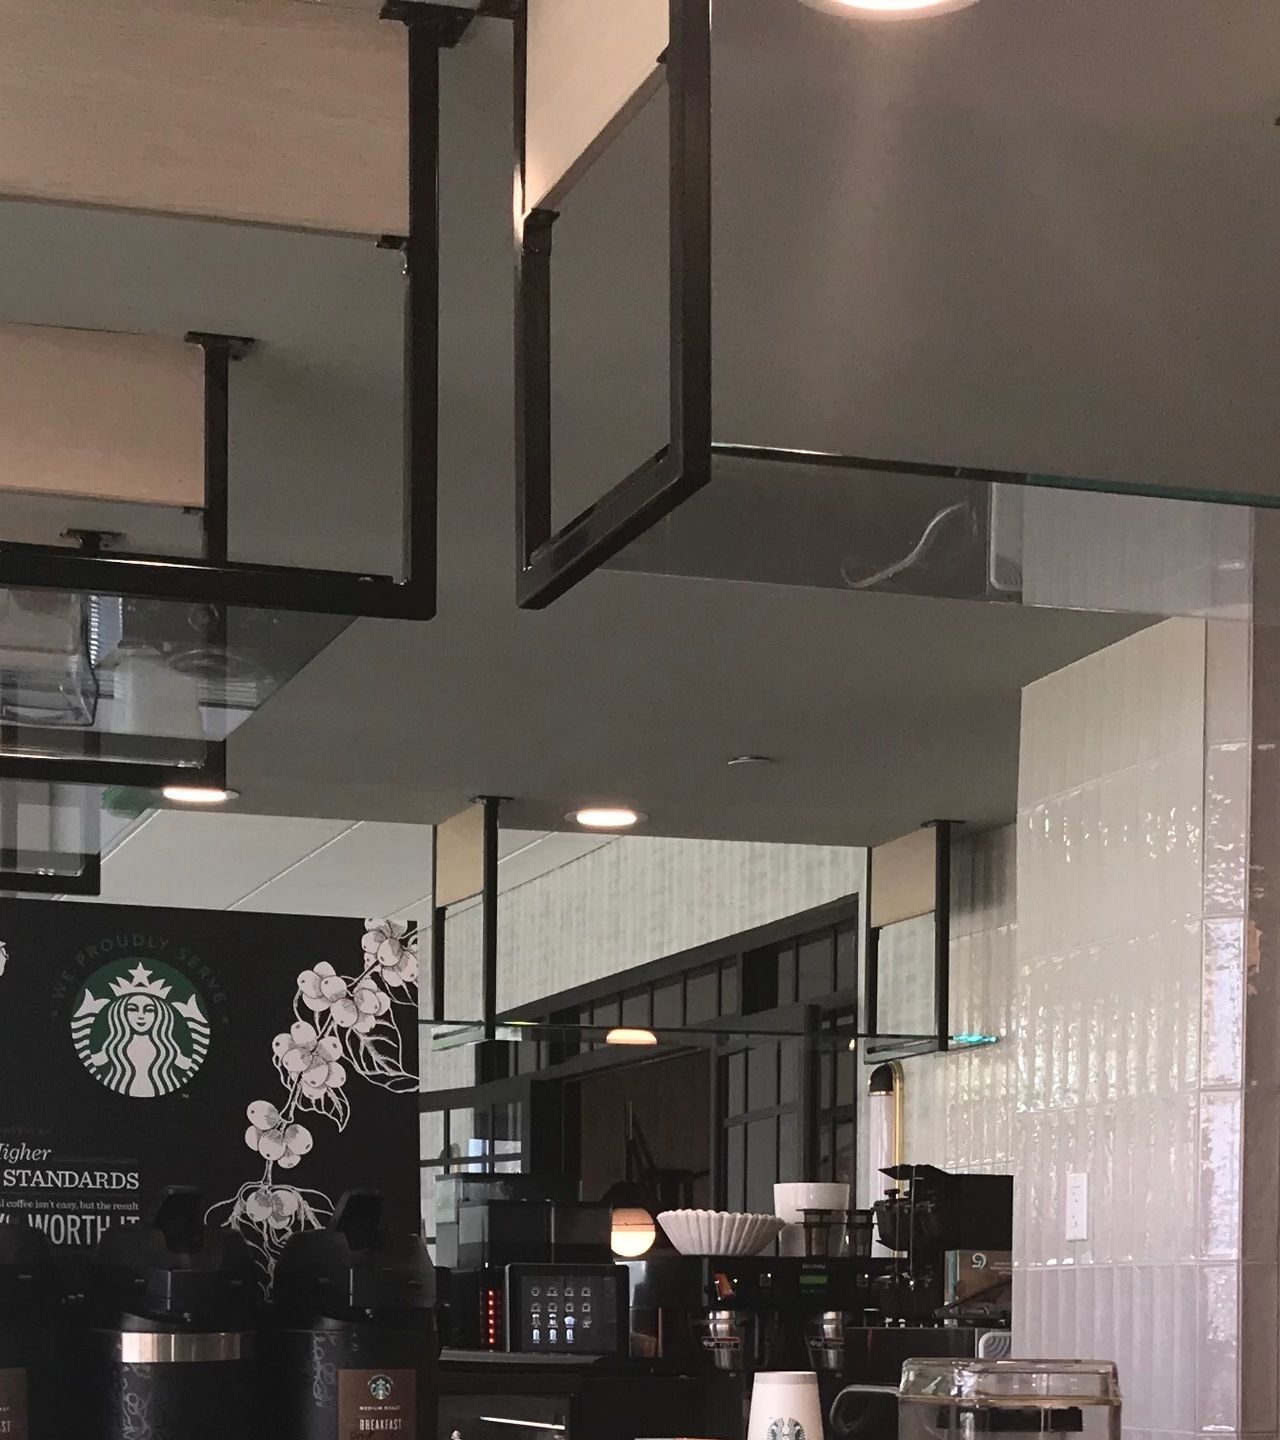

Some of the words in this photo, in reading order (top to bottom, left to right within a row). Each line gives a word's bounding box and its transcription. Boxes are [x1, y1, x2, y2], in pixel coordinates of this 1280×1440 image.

[75, 932, 170, 968] PROUDLY
[176, 947, 227, 1005] SERVE
[2, 1168, 140, 1191] STANDARDS
[6, 1199, 34, 1209] coffee
[34, 1200, 55, 1210] isn't
[79, 1201, 96, 1211] but
[96, 1202, 112, 1211] the
[112, 1203, 140, 1212] result
[359, 1418, 403, 1432] BREAKFAST
